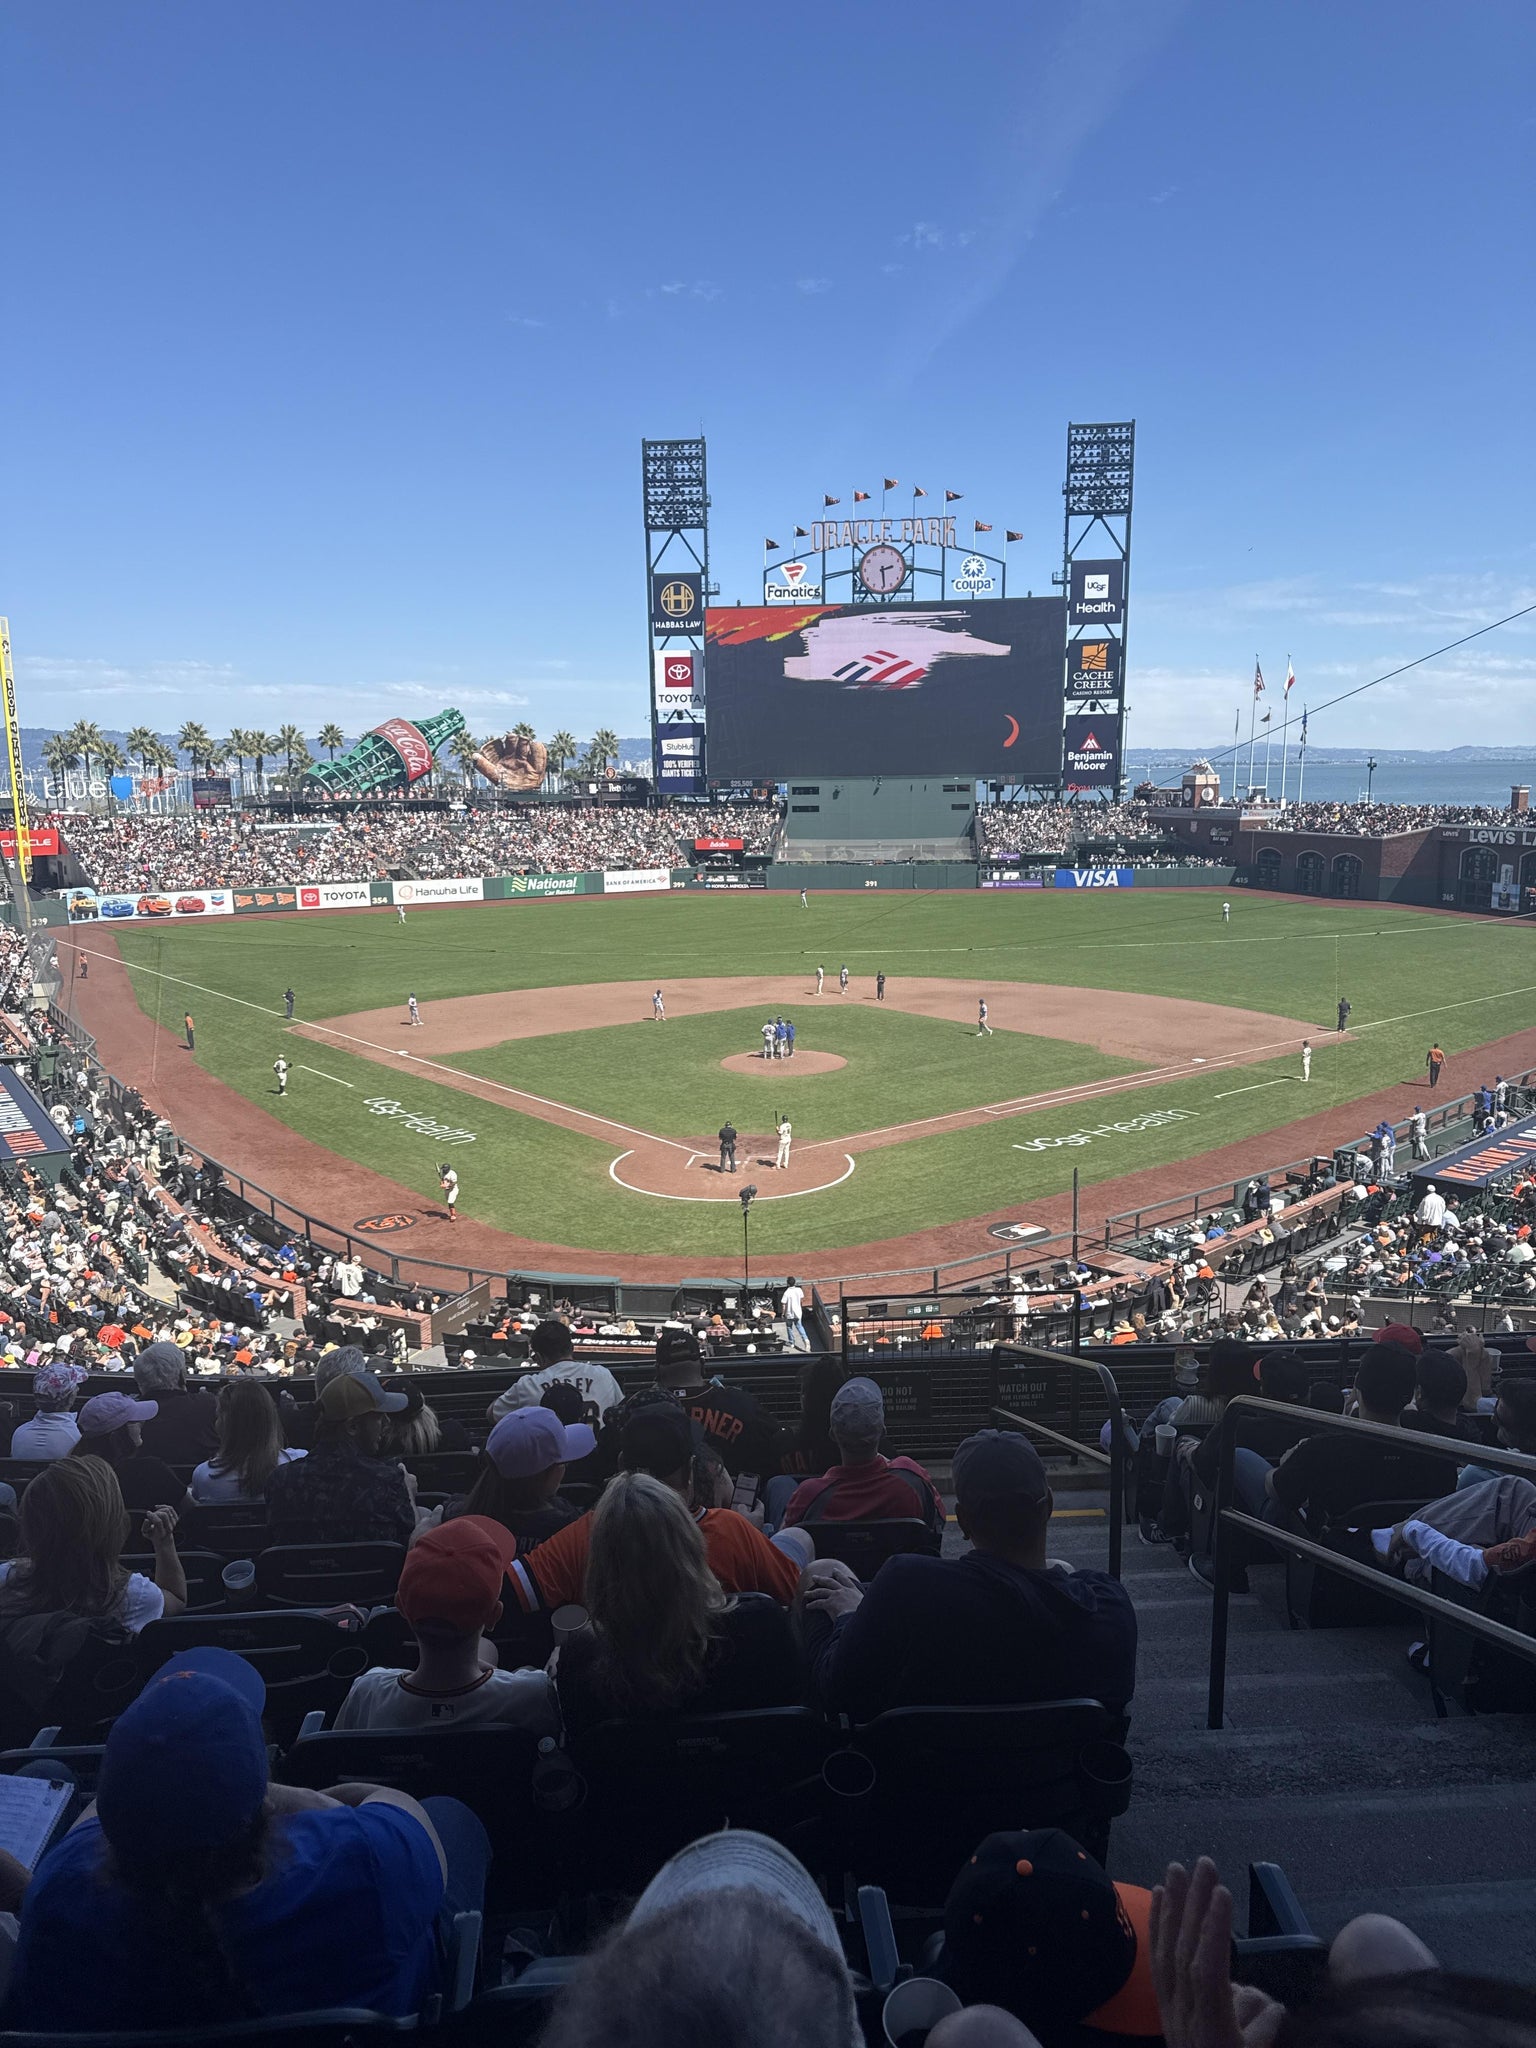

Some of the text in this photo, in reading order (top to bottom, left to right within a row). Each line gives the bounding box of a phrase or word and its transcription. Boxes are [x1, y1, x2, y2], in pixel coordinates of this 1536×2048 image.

[811, 516, 957, 552] ORACLE PARK
[955, 580, 992, 591] coupa
[1087, 582, 1106, 592] UCSF
[767, 585, 821, 599] Fanatics
[1076, 601, 1115, 613] Health
[655, 620, 701, 629] HABBAS LAW
[1073, 671, 1114, 680] CACHE
[1074, 680, 1112, 690] CREEK
[658, 694, 702, 703] TOYOTA
[666, 743, 695, 751] StubHub
[1068, 751, 1113, 763] Benjamin
[1074, 762, 1106, 770] Moore
[662, 769, 702, 777] GIANTS TICKETS
[44, 776, 107, 800] blue
[527, 877, 577, 891] National
[1069, 870, 1119, 887] VISA
[323, 890, 367, 902] TOYOTA
[415, 885, 479, 896] Hanwha Life
[372, 896, 388, 904] 354
[31, 917, 48, 926] 339
[363, 1097, 478, 1145] UCSF Health
[1012, 1109, 1200, 1152] UCSF Health
[1434, 1147, 1528, 1181] WELCOME
[895, 1386, 913, 1396] NOT
[999, 1382, 1048, 1394] WATCH OUT
